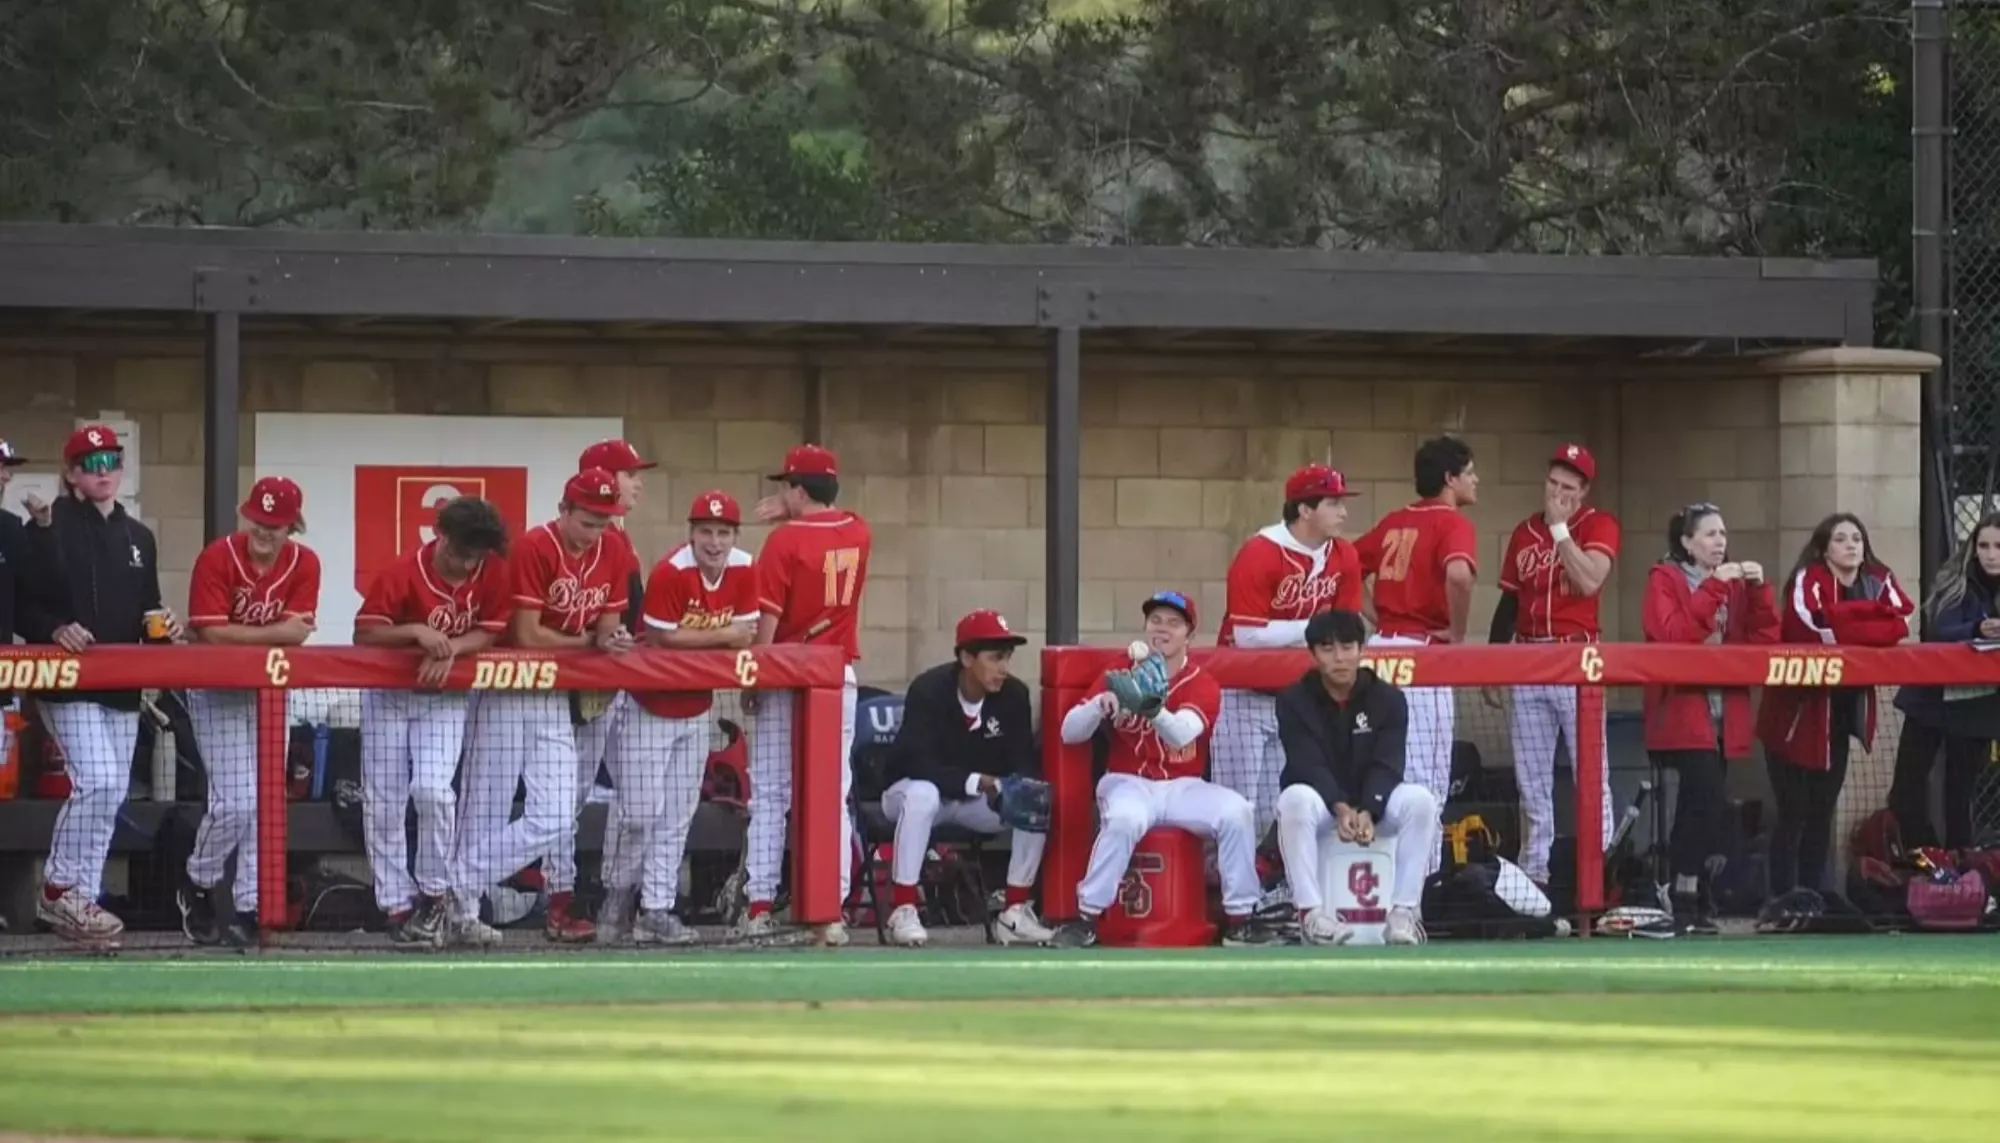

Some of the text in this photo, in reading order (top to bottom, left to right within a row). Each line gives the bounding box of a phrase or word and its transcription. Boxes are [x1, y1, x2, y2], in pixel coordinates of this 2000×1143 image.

[823, 548, 859, 606] 17
[0, 659, 80, 689] DONS
[266, 648, 290, 686] CC
[471, 660, 558, 689] DONS
[736, 650, 759, 686] CC
[1581, 646, 1604, 682] CC
[1764, 656, 1844, 686] DONS
